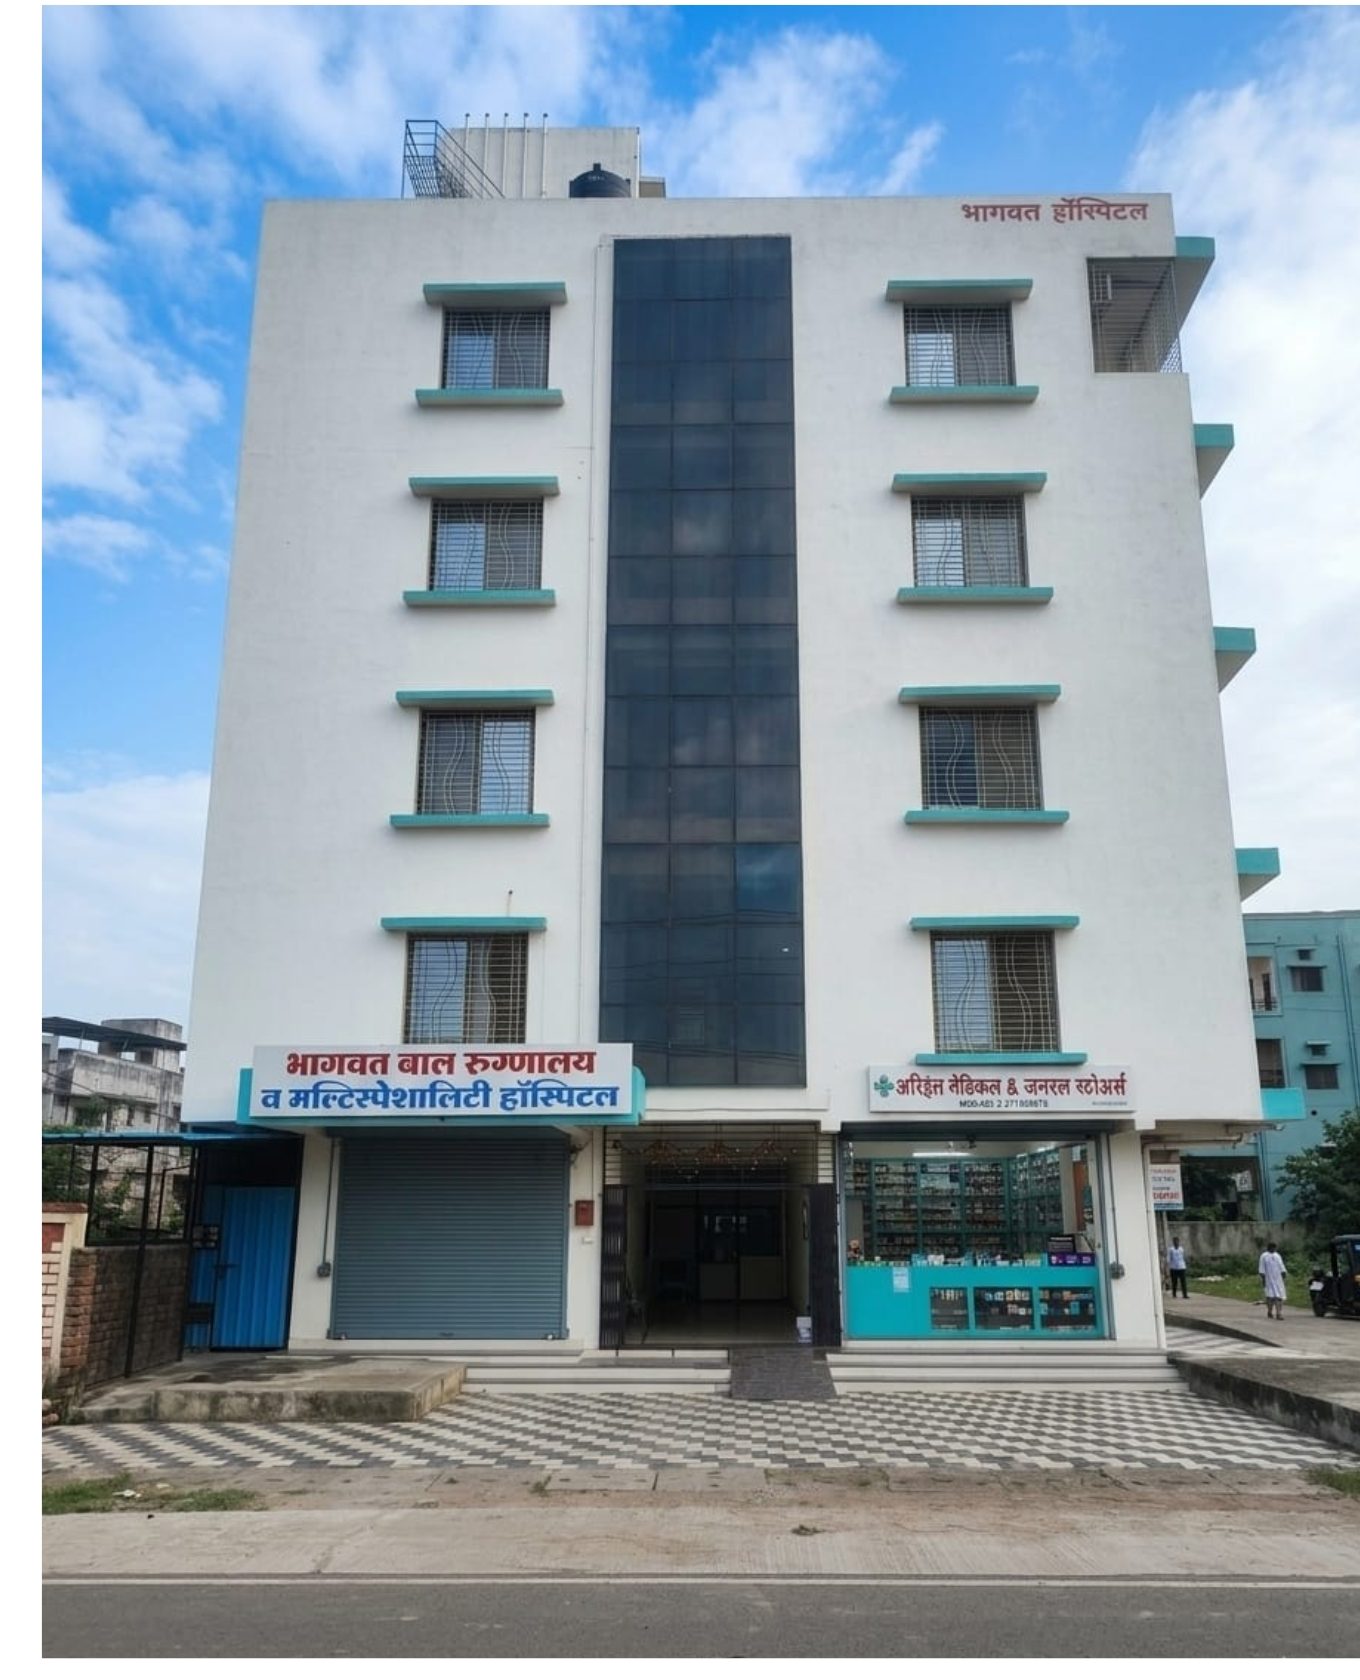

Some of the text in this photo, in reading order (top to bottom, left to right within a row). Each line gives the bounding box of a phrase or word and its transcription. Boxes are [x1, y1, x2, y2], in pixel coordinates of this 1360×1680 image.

[961, 197, 1149, 224] भागवत हॉस्पिटल
[286, 1052, 596, 1075] भागवत बाल रुग्णालय
[261, 1078, 619, 1111] व मल्टिस्पेशालिटी हॉस्पिटल
[1006, 1078, 1018, 1096] &
[1023, 1078, 1071, 1096] जनरल
